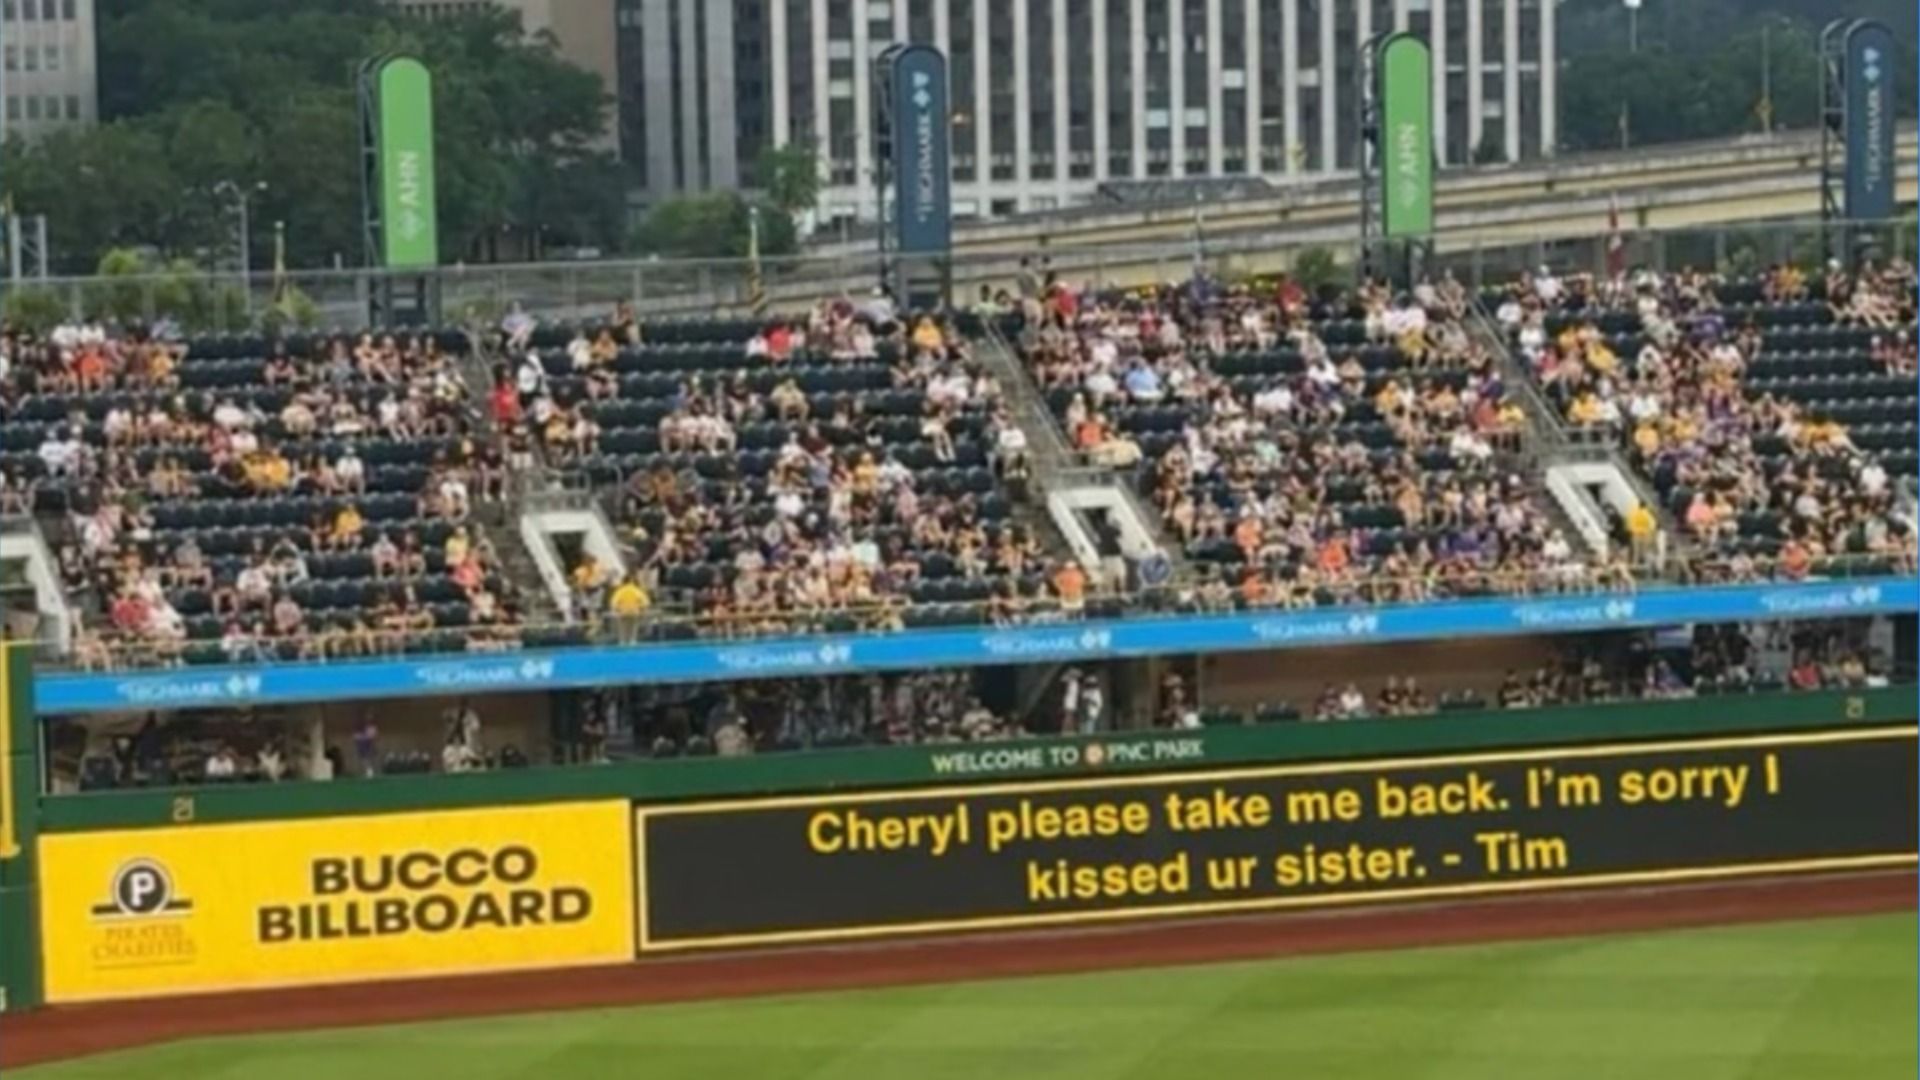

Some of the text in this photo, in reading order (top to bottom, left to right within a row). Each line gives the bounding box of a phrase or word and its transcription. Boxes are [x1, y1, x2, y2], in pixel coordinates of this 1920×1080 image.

[1398, 123, 1421, 176] AHN
[397, 150, 420, 206] AHN
[931, 738, 1205, 773] WELCOME TO PNC PARK
[808, 753, 1779, 855] Cheryl please take me back. I'm sorry I
[130, 872, 156, 908] P
[312, 846, 537, 896] BUCCO
[1027, 831, 1567, 901] kissed ur sister. - Tim
[258, 887, 592, 943] BILLBOARD
